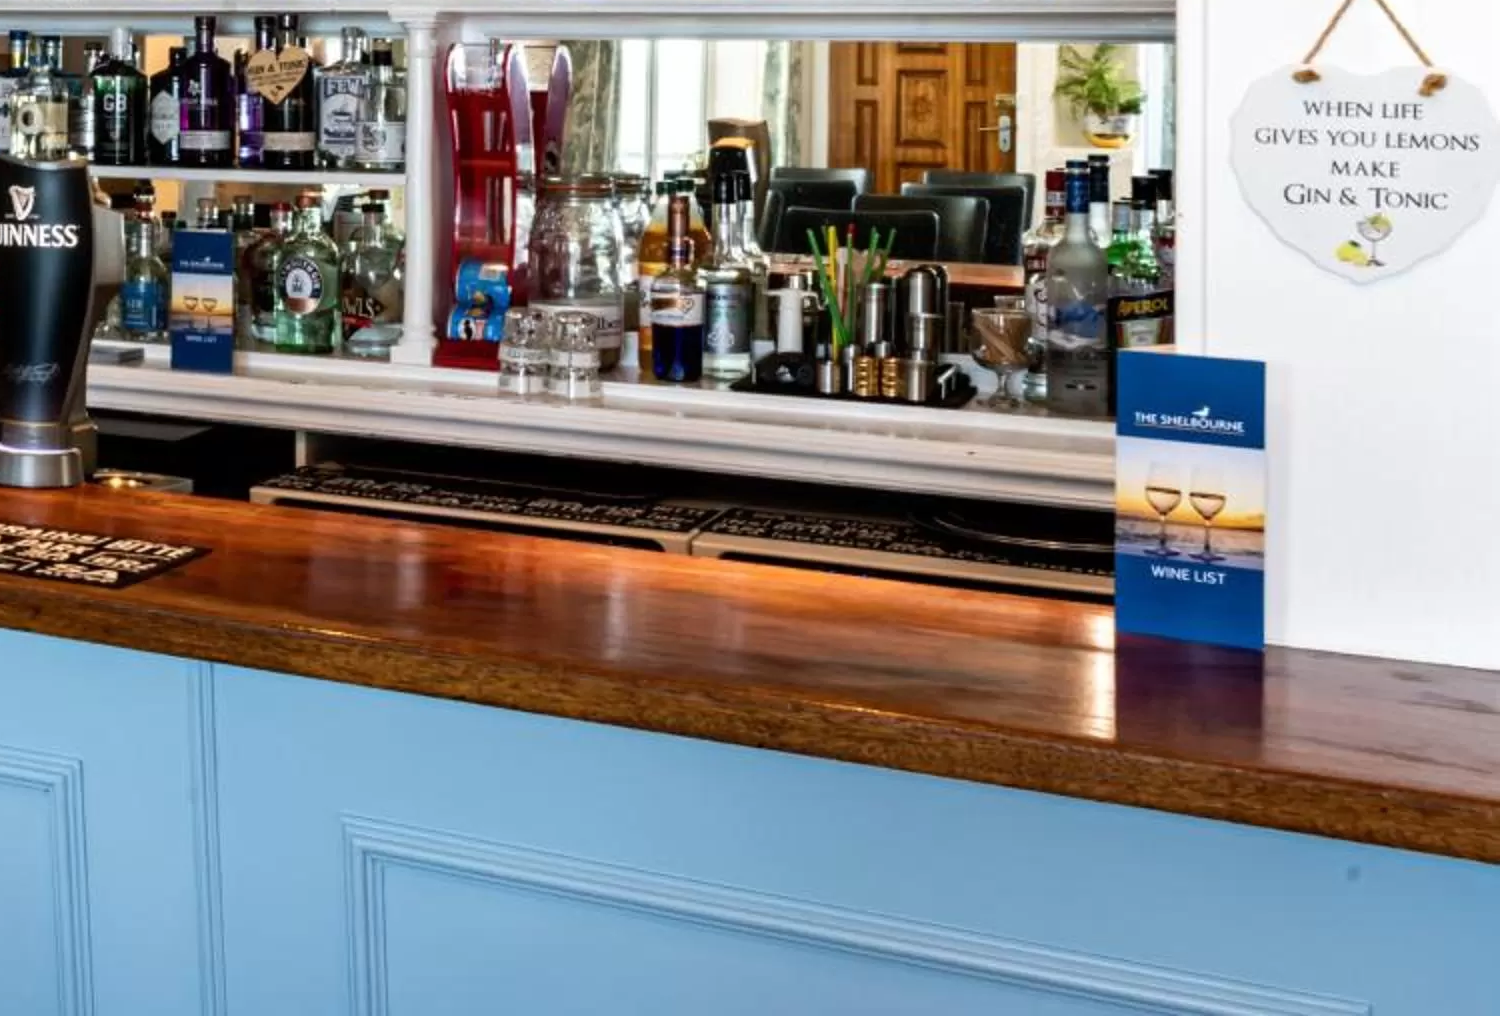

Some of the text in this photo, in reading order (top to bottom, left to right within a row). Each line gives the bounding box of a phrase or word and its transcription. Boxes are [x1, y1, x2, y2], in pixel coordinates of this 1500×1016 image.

[1303, 100, 1423, 120] WHEN LIFE
[1254, 127, 1481, 152] GIVES YOU LEMONS
[1330, 160, 1401, 178] MAKE
[1338, 187, 1357, 206] &
[1116, 292, 1170, 317] APEROL
[1134, 410, 1245, 433] THE SHELBOURNE
[1151, 564, 1228, 585] WINE LIST
